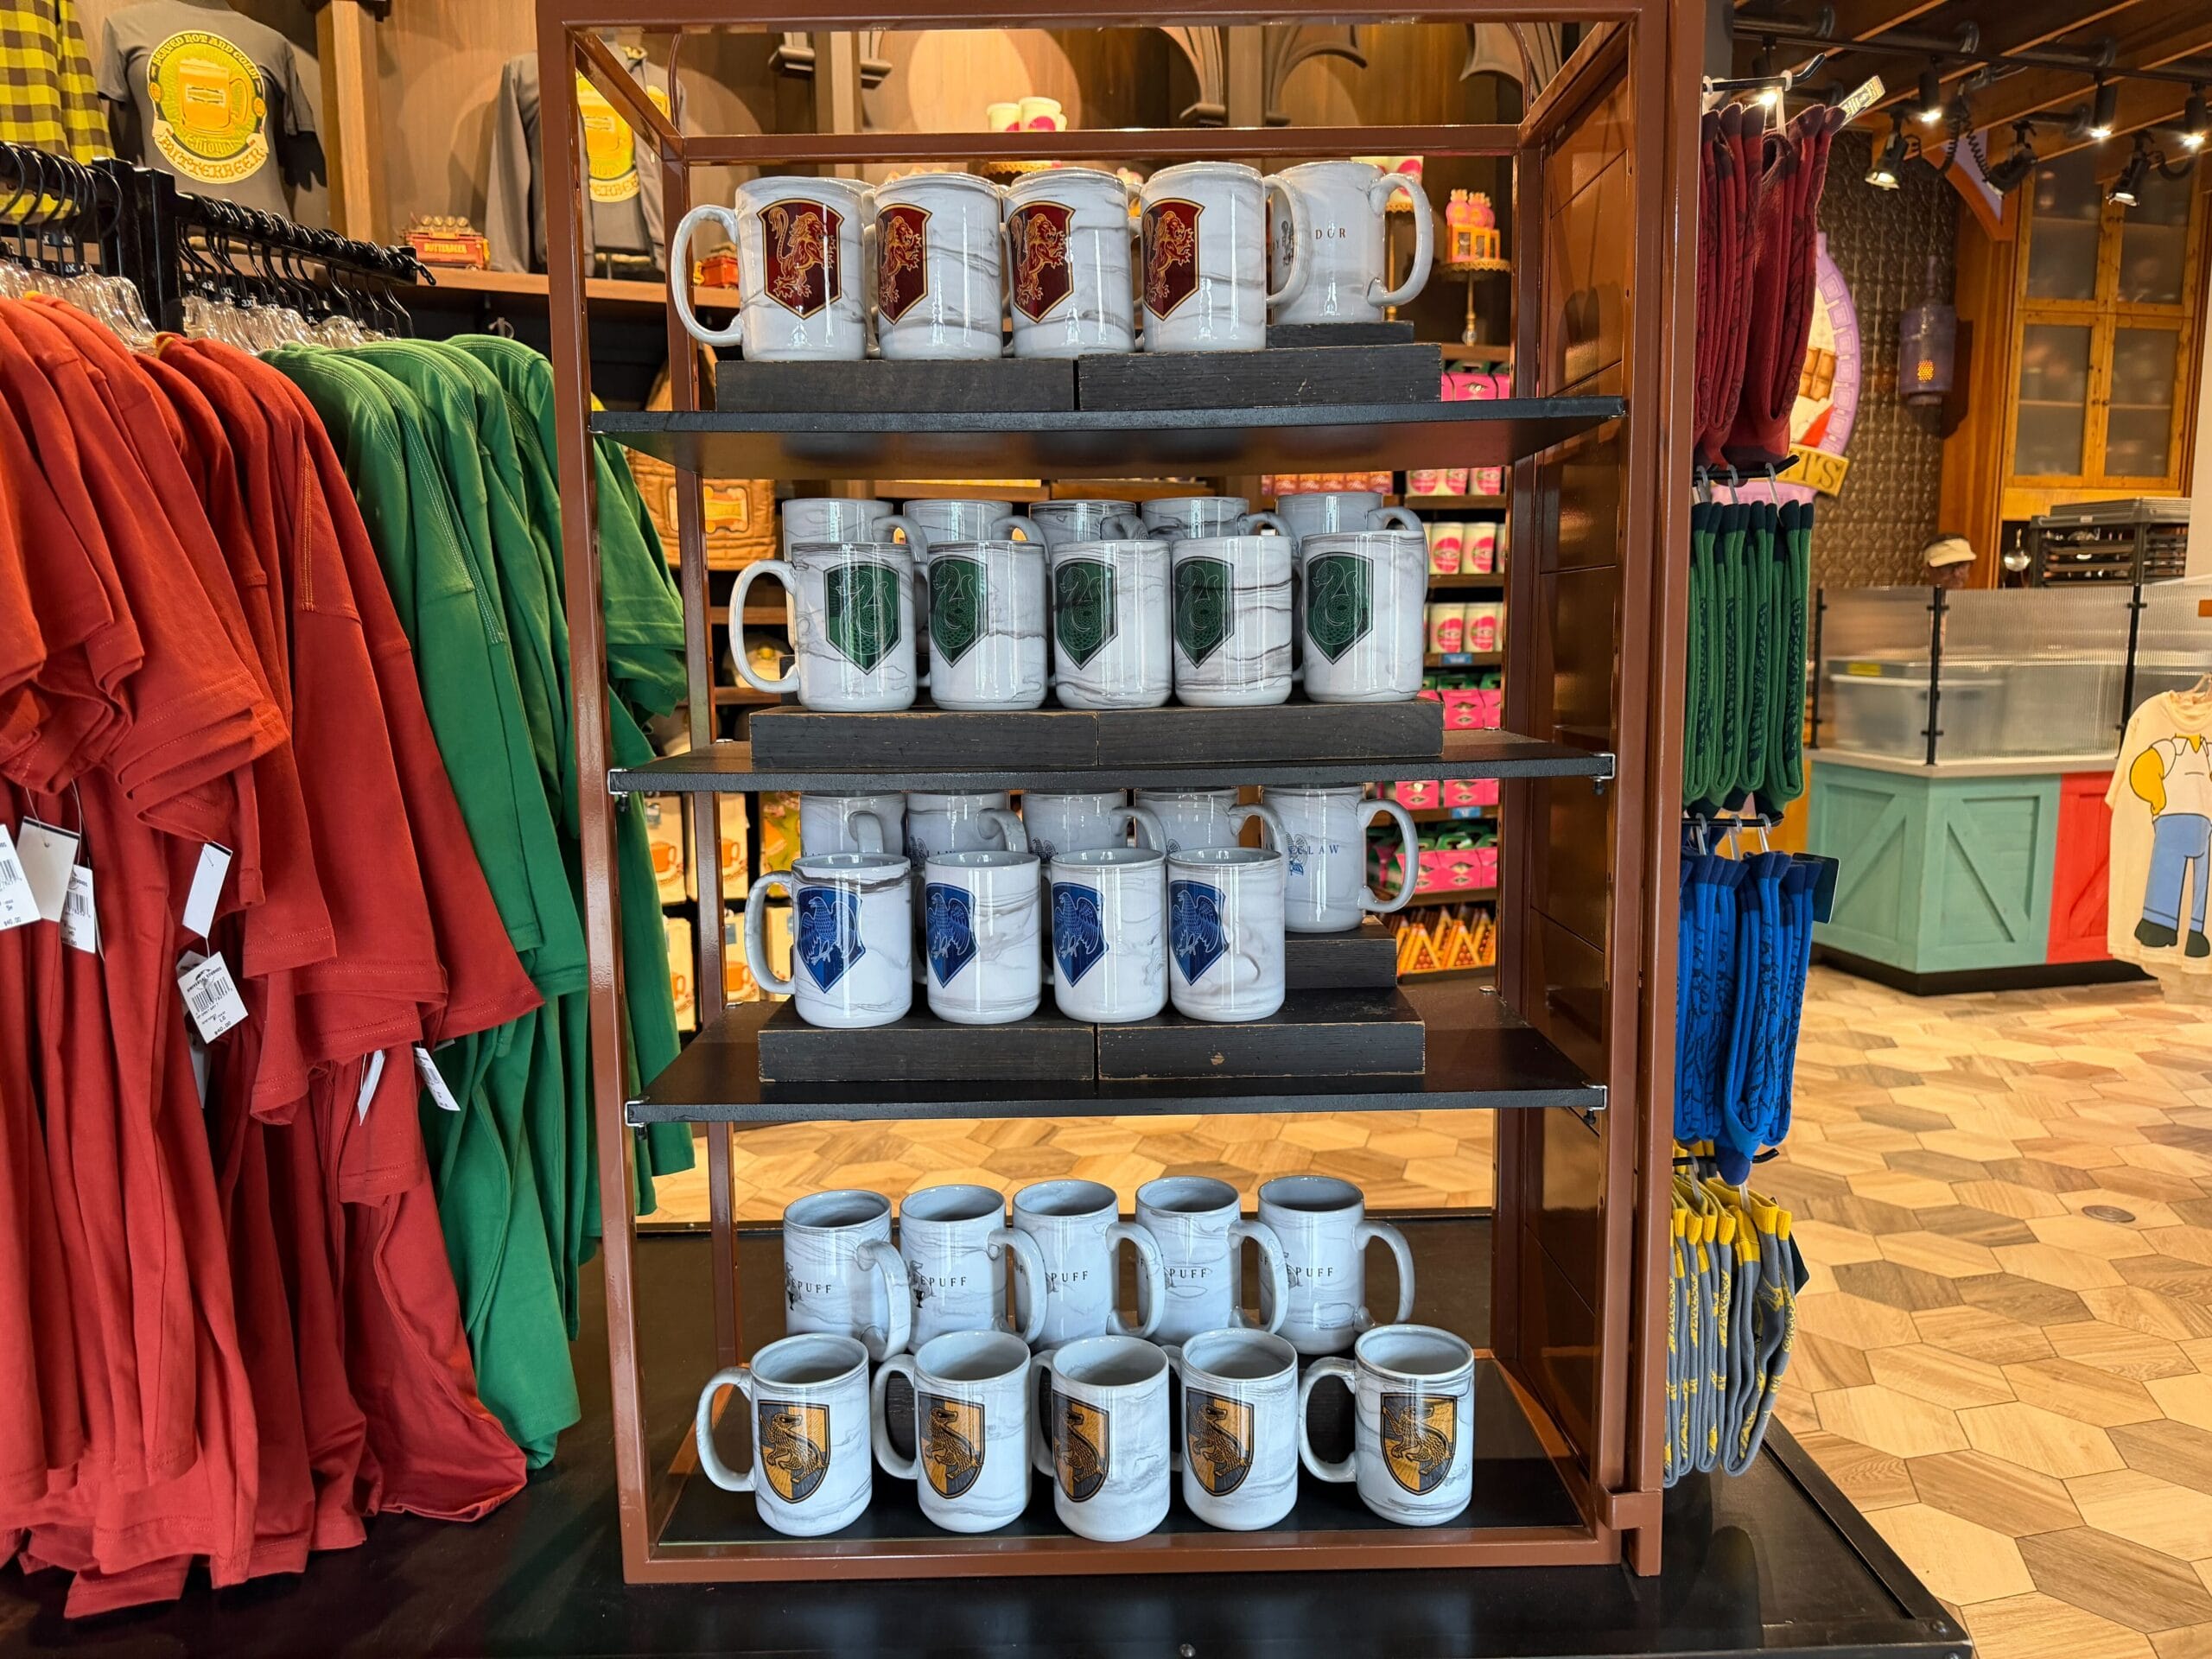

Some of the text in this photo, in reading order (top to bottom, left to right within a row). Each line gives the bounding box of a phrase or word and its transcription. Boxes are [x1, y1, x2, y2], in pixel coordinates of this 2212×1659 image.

[184, 35, 208, 44] HOT
[208, 37, 235, 54] AND
[159, 137, 265, 179] BUTTERBEER
[214, 1021, 232, 1035] $40.00
[1051, 1270, 1089, 1282] PUFF
[1169, 1268, 1207, 1279] PUFF
